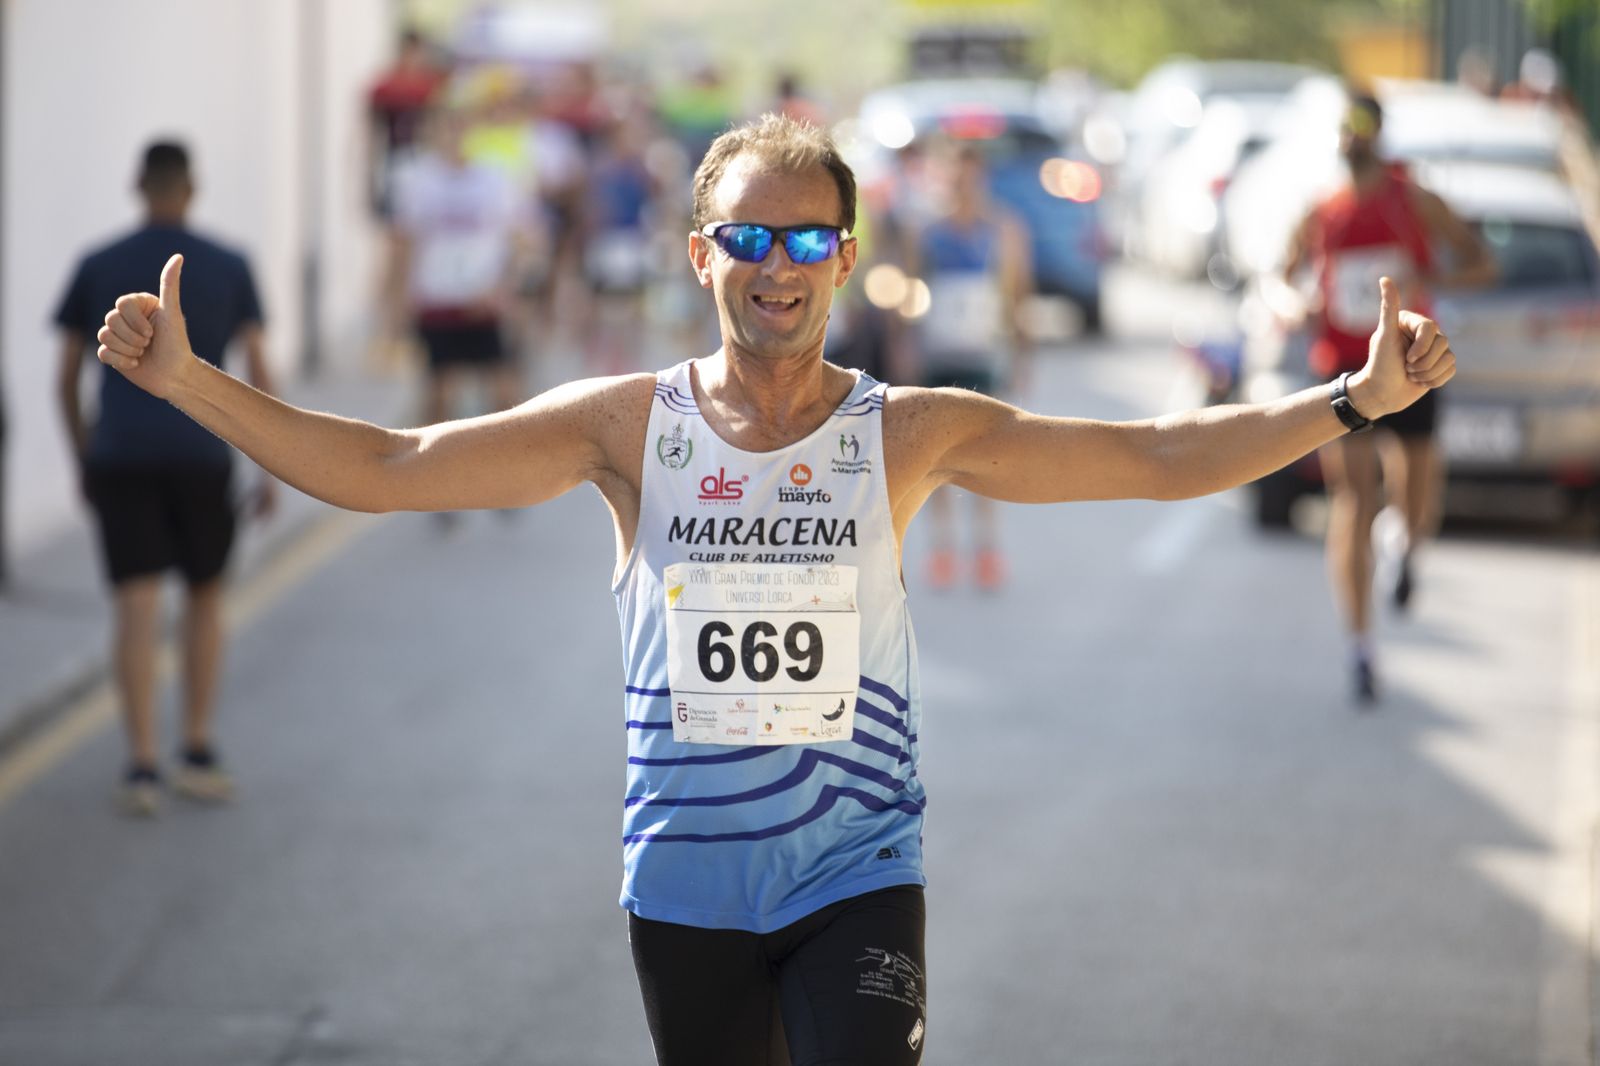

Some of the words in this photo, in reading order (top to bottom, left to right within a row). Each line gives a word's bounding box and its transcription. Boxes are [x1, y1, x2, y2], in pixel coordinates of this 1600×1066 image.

[778, 489, 832, 505] mayfo
[669, 516, 857, 546] MARACENA
[689, 552, 725, 563] CLUB
[730, 552, 748, 563] DE
[752, 553, 835, 563] ATLETISMO
[818, 571, 840, 586] 2023
[697, 621, 823, 683] 669
